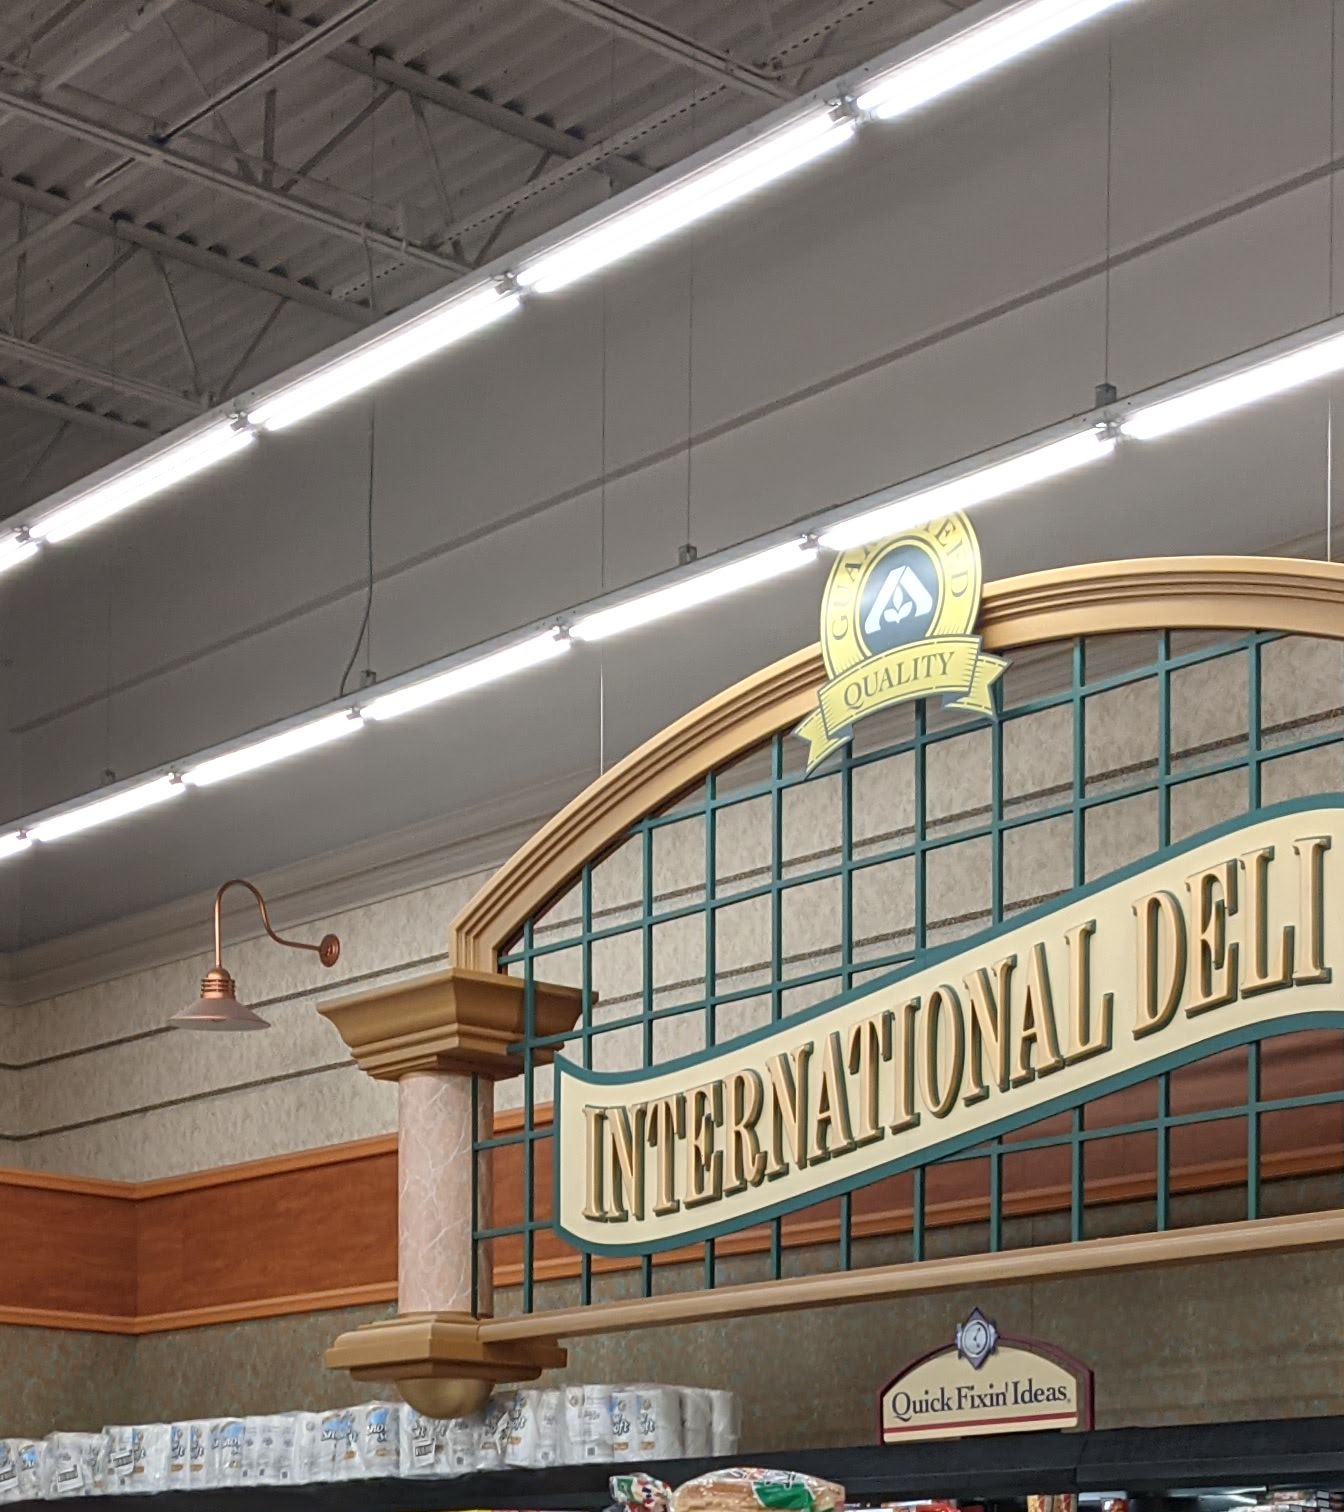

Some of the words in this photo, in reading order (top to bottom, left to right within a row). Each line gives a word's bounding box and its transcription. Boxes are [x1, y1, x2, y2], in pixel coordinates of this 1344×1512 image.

[843, 650, 955, 710] QUALITY
[582, 917, 1113, 1223] INTERNATIONAL
[1130, 835, 1332, 1040] DELI
[892, 1387, 953, 1422] Quick
[1012, 1378, 1068, 1405] Ideas
